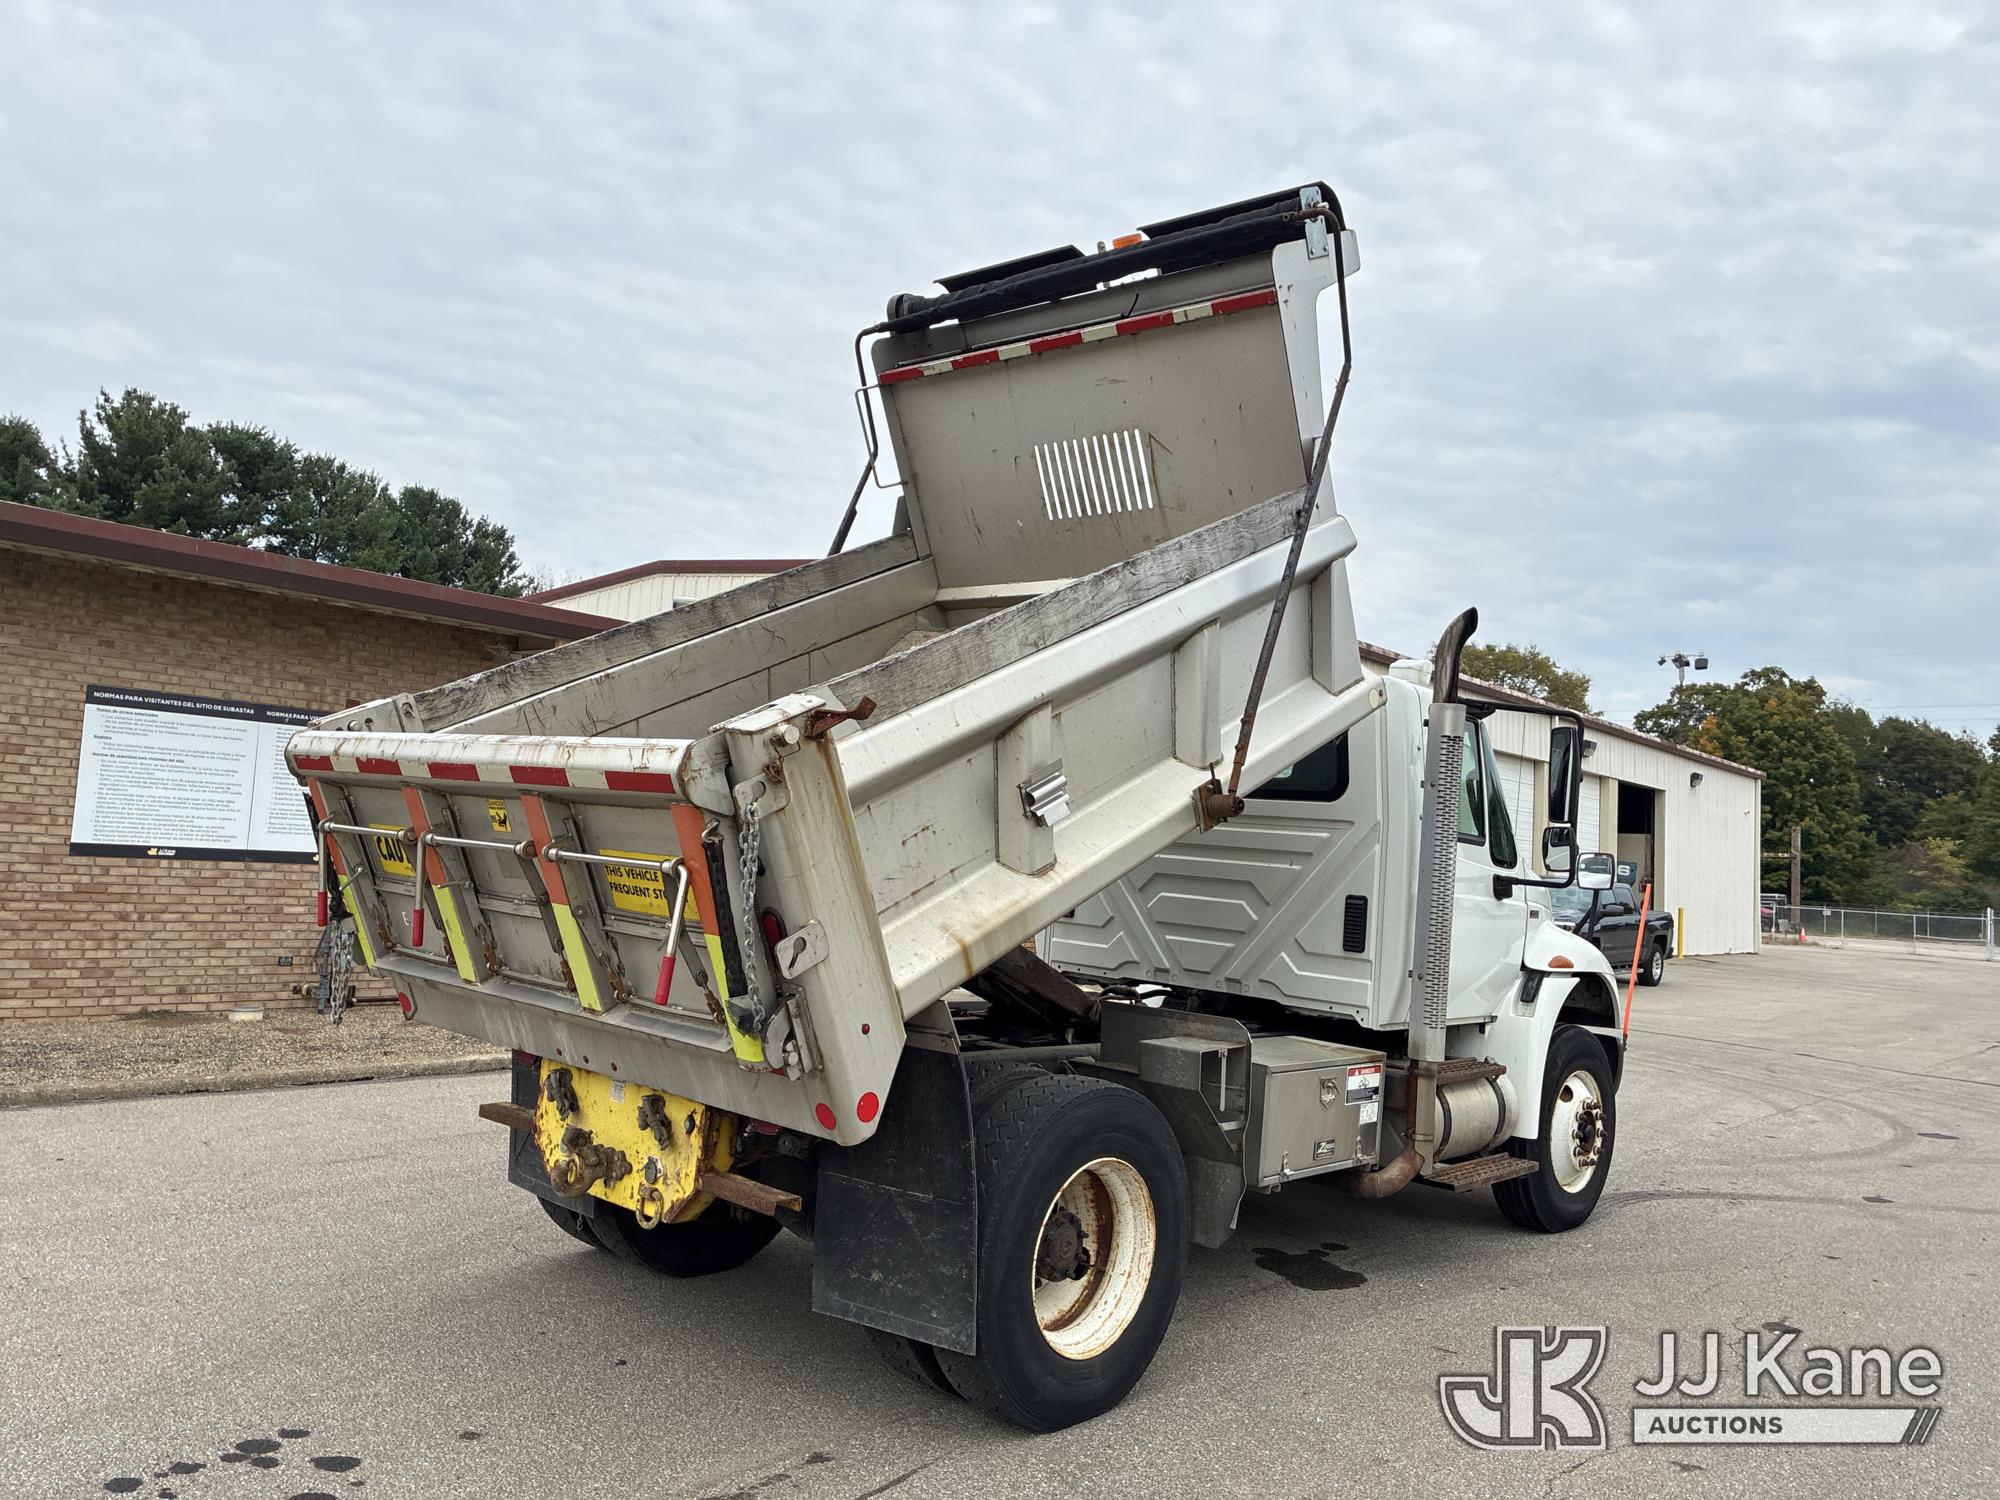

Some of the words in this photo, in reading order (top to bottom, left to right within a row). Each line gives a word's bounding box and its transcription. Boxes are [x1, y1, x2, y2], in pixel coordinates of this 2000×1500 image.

[93, 691, 124, 700] NORMAS
[124, 694, 144, 702] PARA
[144, 697, 182, 707] VISITANTES
[223, 706, 255, 715] SUBASTAS
[605, 865, 623, 878] THIS
[624, 868, 659, 882] VEHICLE
[1617, 864, 1630, 876] 6
[608, 882, 650, 898] FREQUENT
